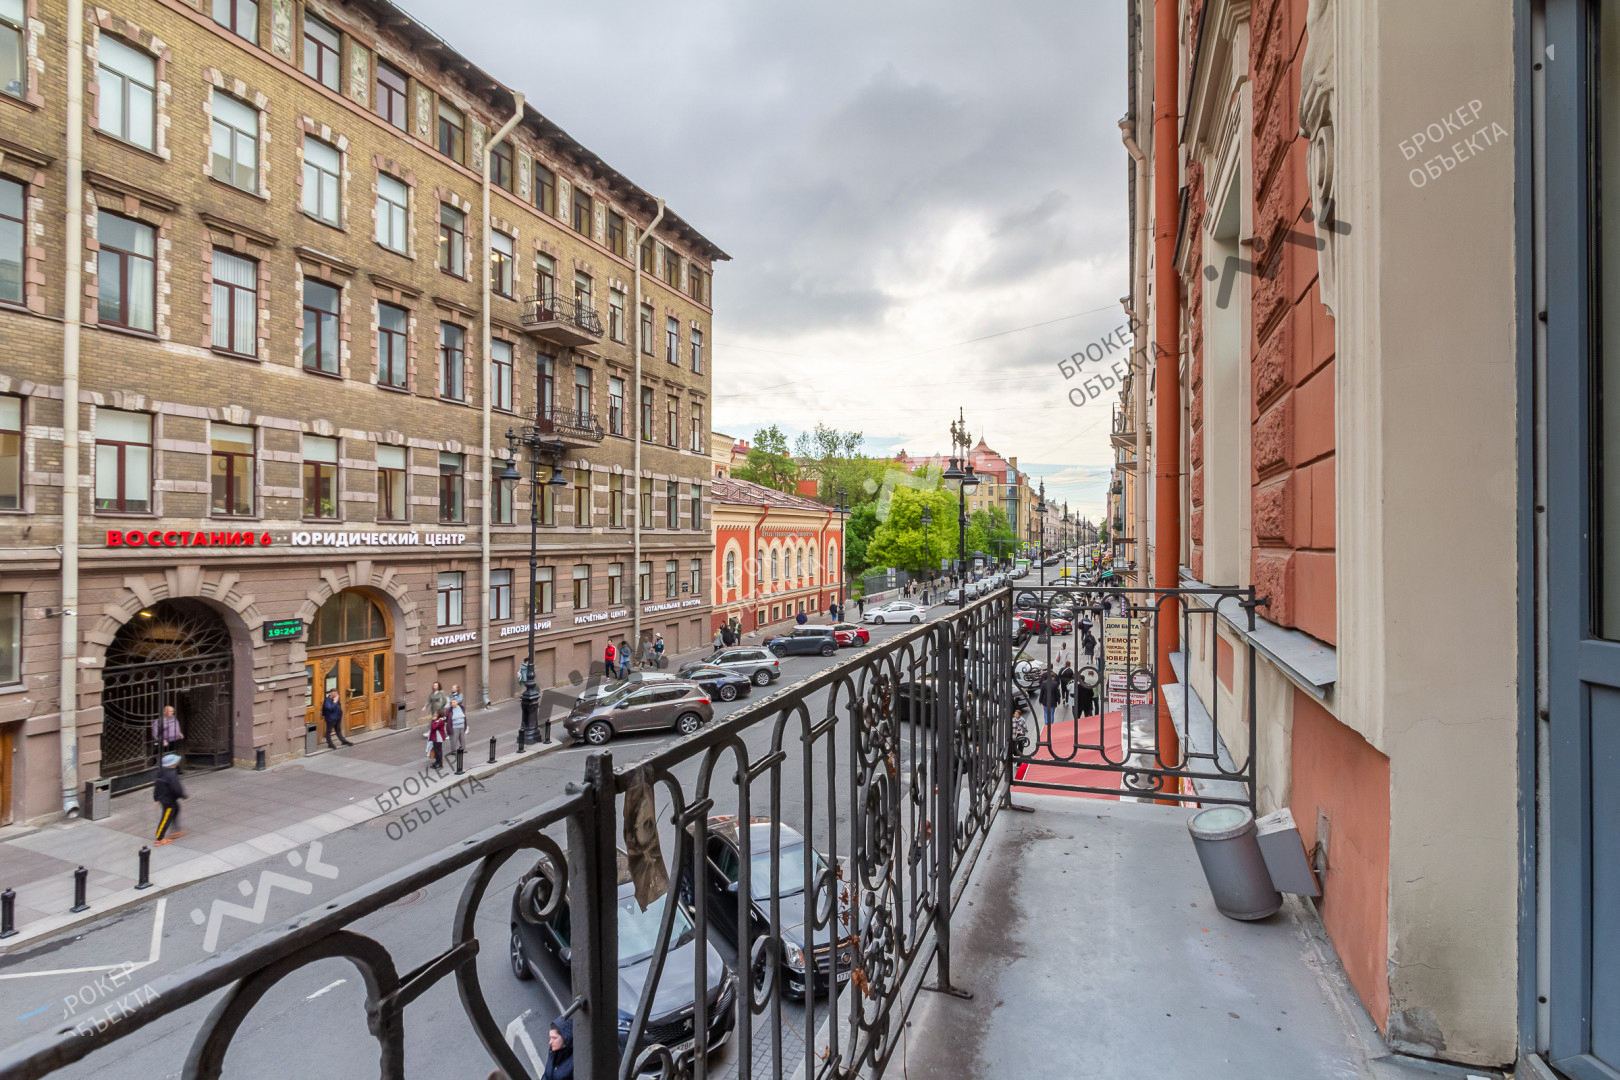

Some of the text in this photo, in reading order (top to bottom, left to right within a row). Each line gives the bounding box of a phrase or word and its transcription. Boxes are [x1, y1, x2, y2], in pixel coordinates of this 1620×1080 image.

[106, 530, 466, 547] ВОССТАНИЯ 6 ЮРИДИЧЕСКИЙ ЦЕНТР
[644, 601, 680, 613] НОТАРИАЛЬНАЯ
[574, 609, 627, 624] РАСЧЁТНЫЙ ЦЕНТР
[500, 620, 552, 637] ДЕПОЗИАРИЙ
[430, 631, 477, 647] НОТАРИУС
